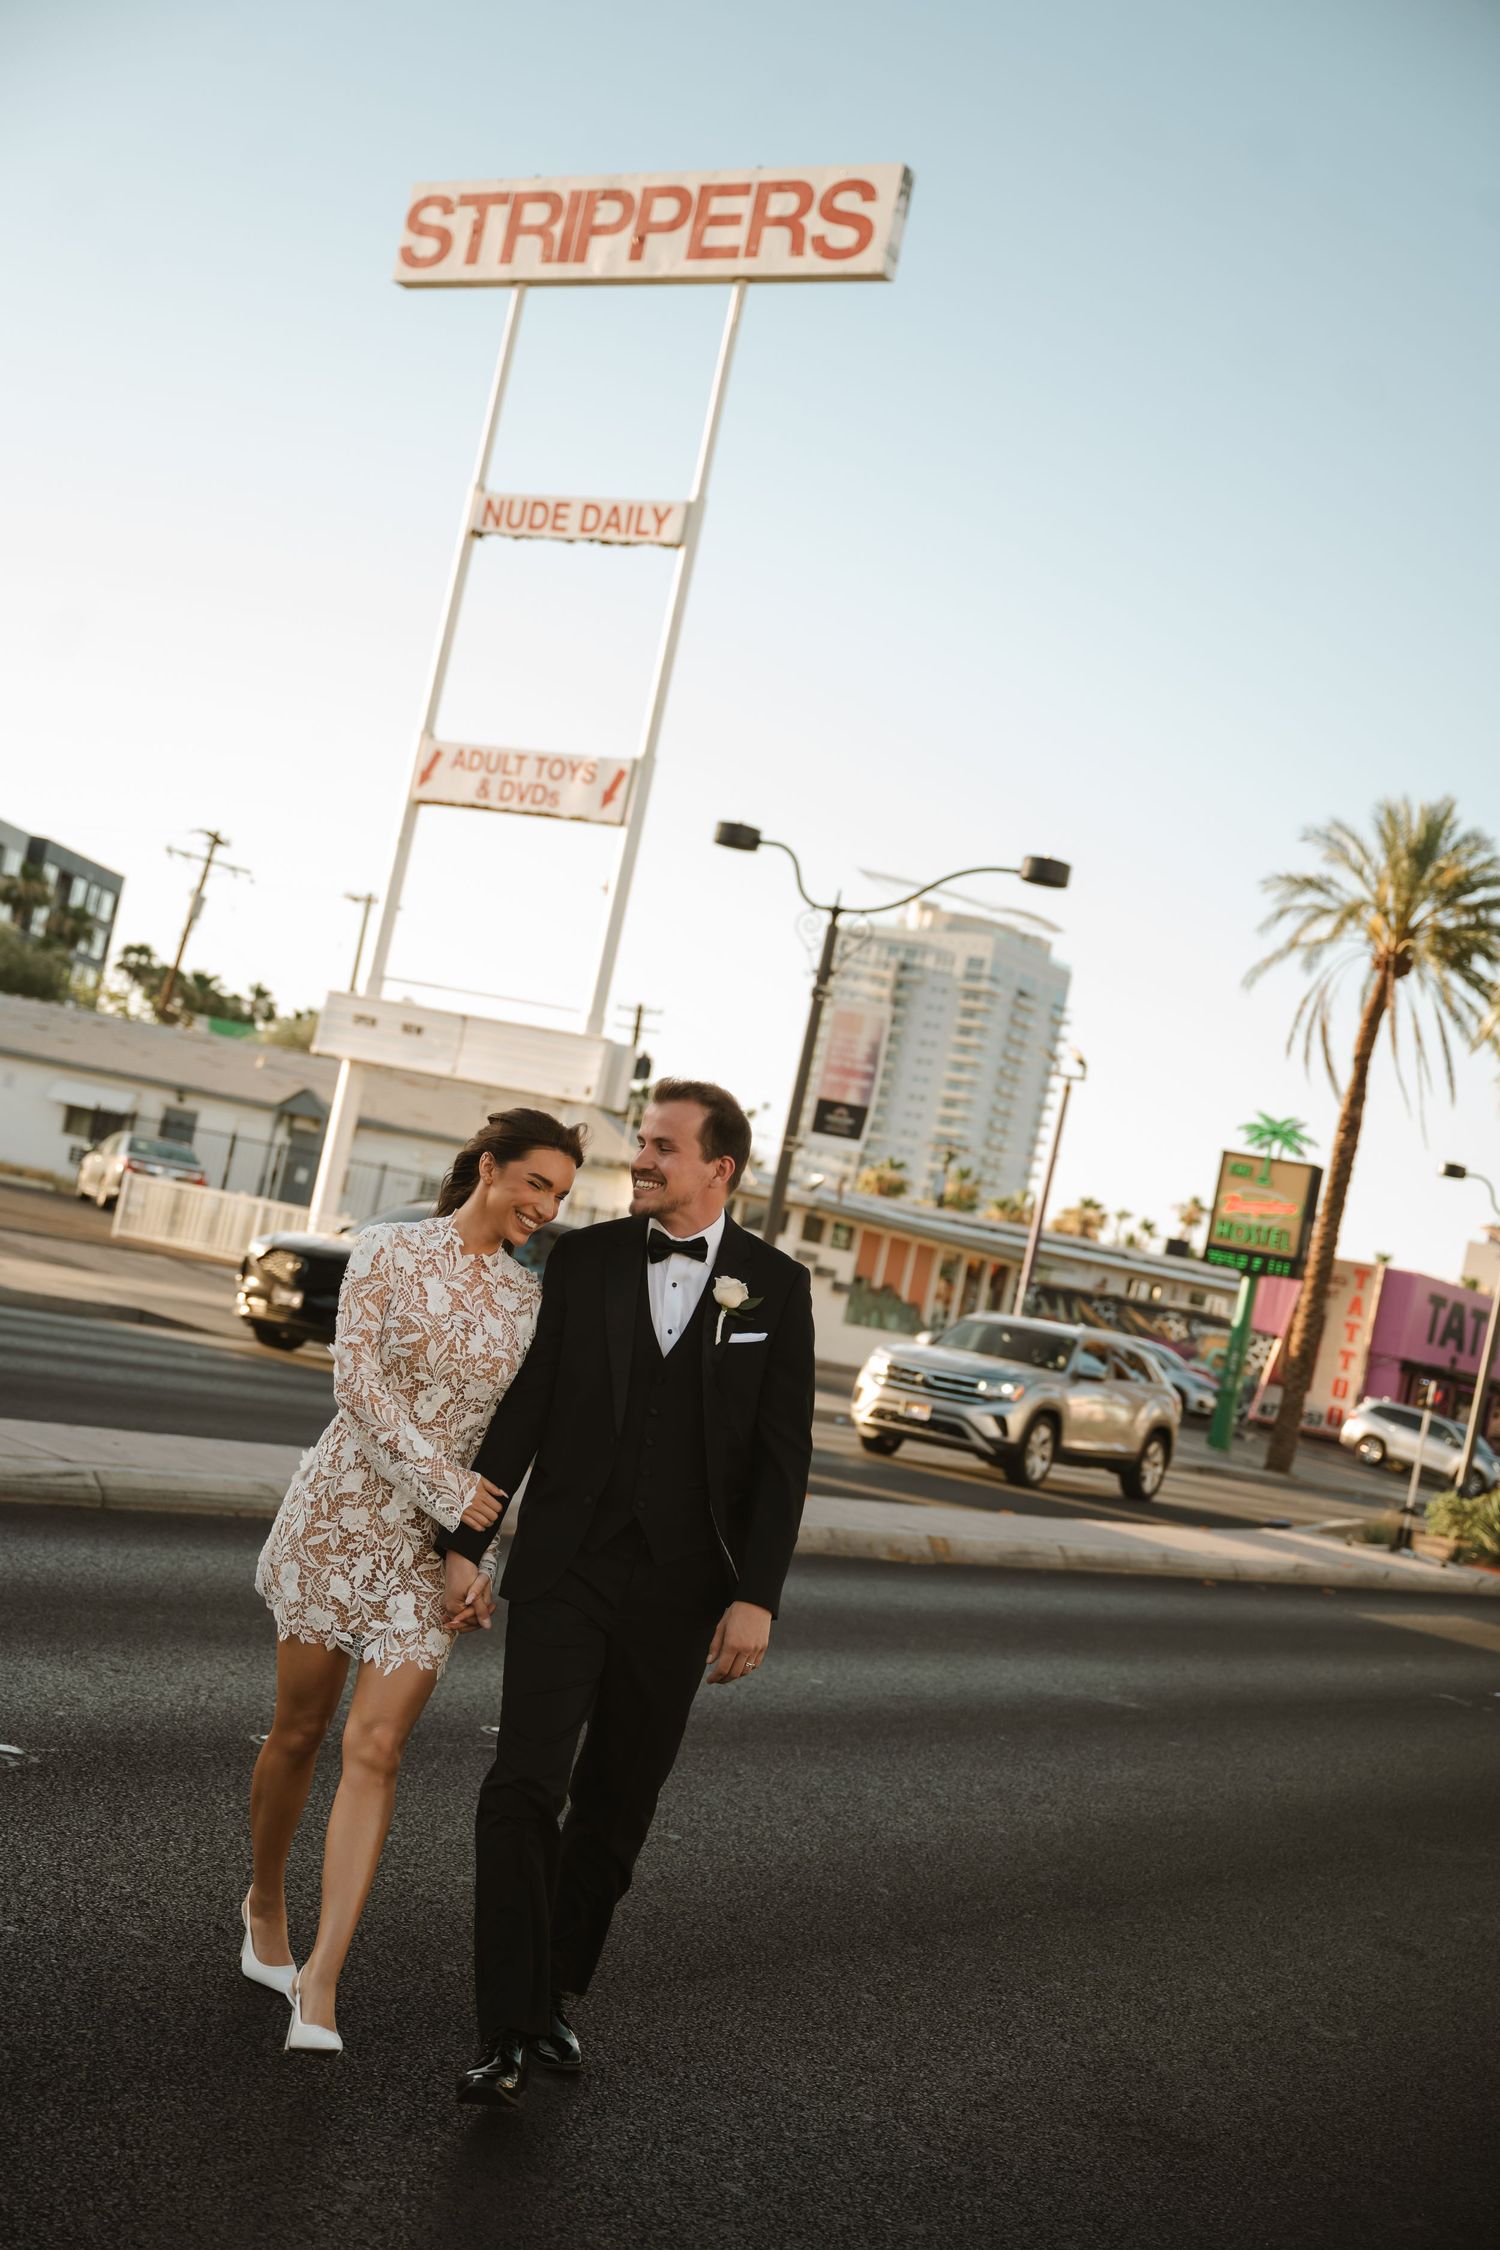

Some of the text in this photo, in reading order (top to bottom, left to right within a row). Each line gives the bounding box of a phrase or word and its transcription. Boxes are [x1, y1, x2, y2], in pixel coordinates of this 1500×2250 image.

[400, 179, 878, 268] STRIPPERS
[481, 497, 672, 537] NUDE DAILY
[451, 747, 598, 785] ADULT TOYS
[475, 777, 560, 807] & DVDs
[1215, 1219, 1290, 1252] HOSTEL
